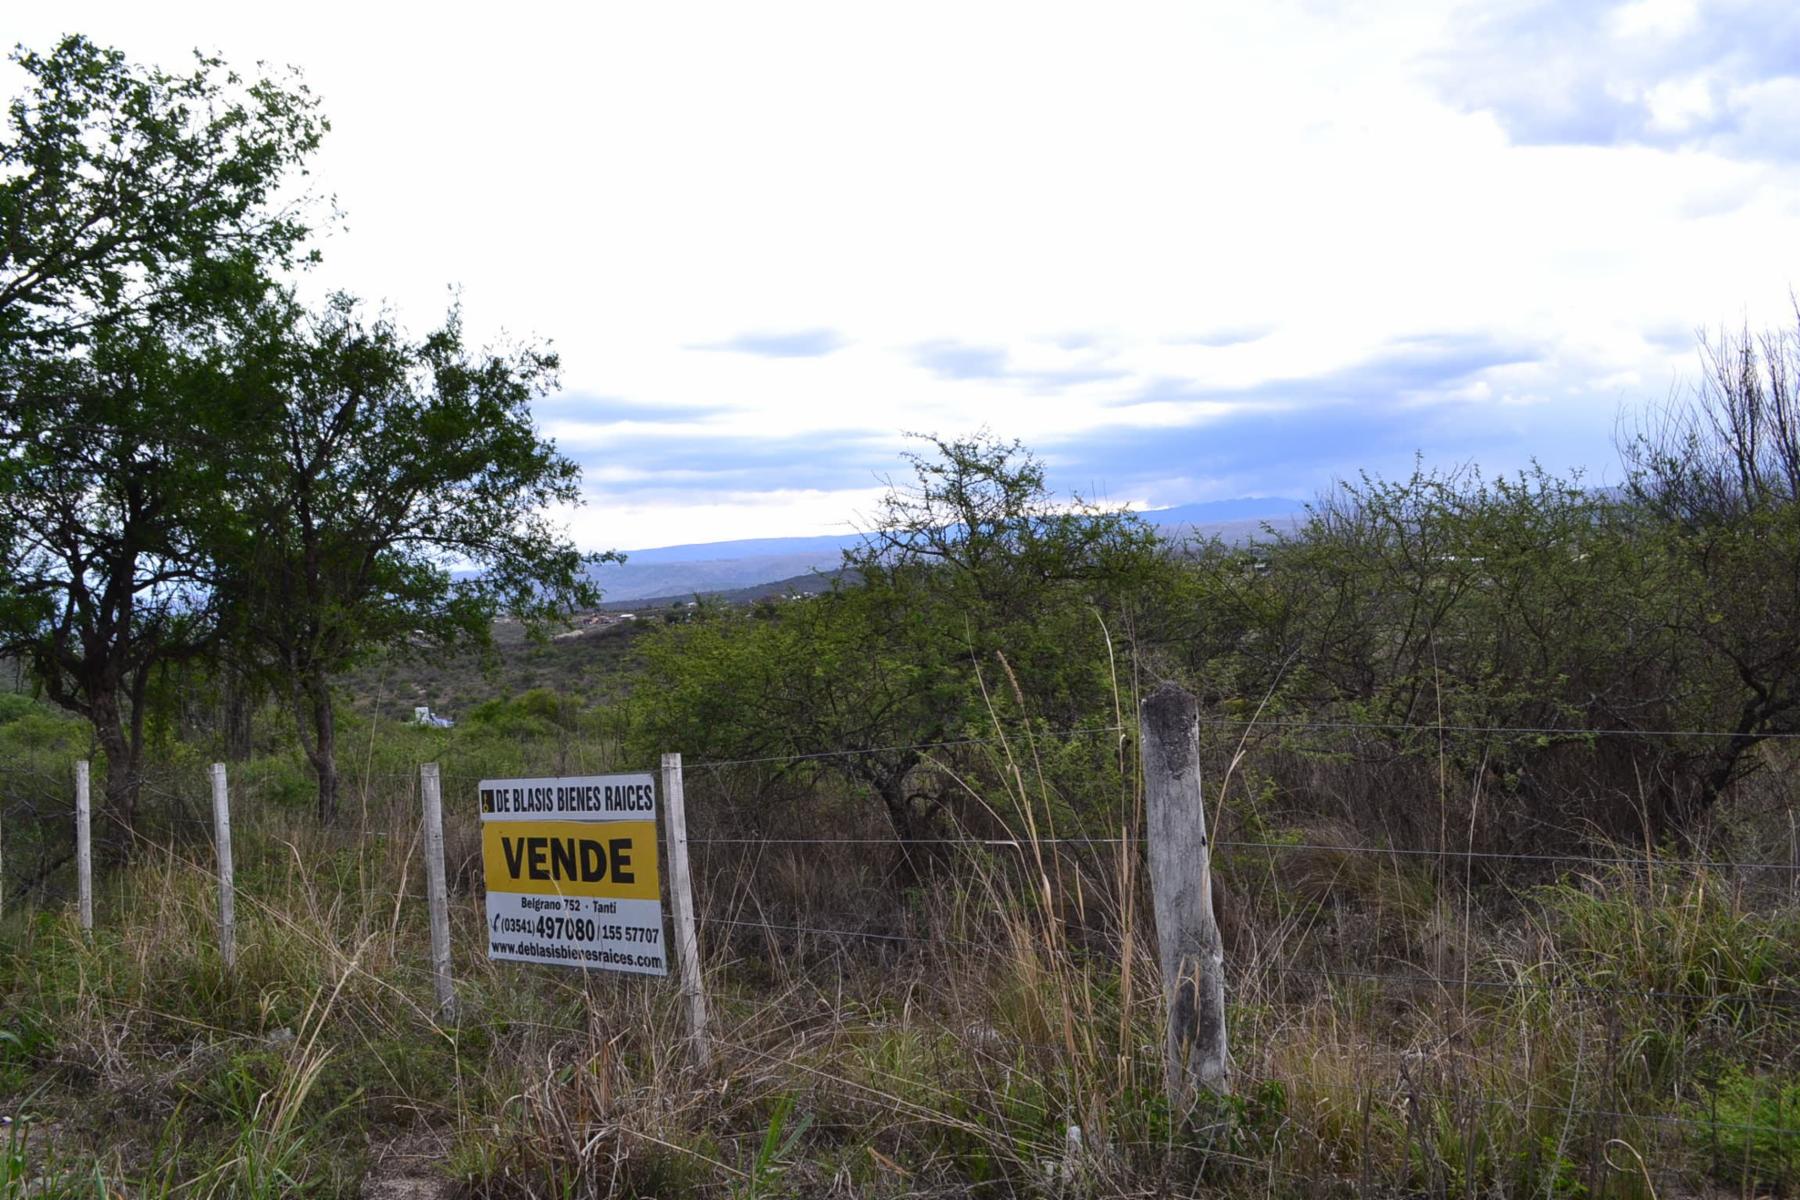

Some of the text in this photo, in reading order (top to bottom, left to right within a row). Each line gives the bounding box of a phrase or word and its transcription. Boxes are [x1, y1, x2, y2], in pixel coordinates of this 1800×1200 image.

[496, 784, 653, 813] DE BLASIS BIENES RAICES
[501, 837, 635, 884] VENDE
[521, 897, 561, 912] Belgrano
[563, 899, 581, 911] 752
[592, 900, 617, 914] Tanti
[625, 926, 659, 944] 57707
[491, 941, 663, 969] www.deblasisbienesraices.com
